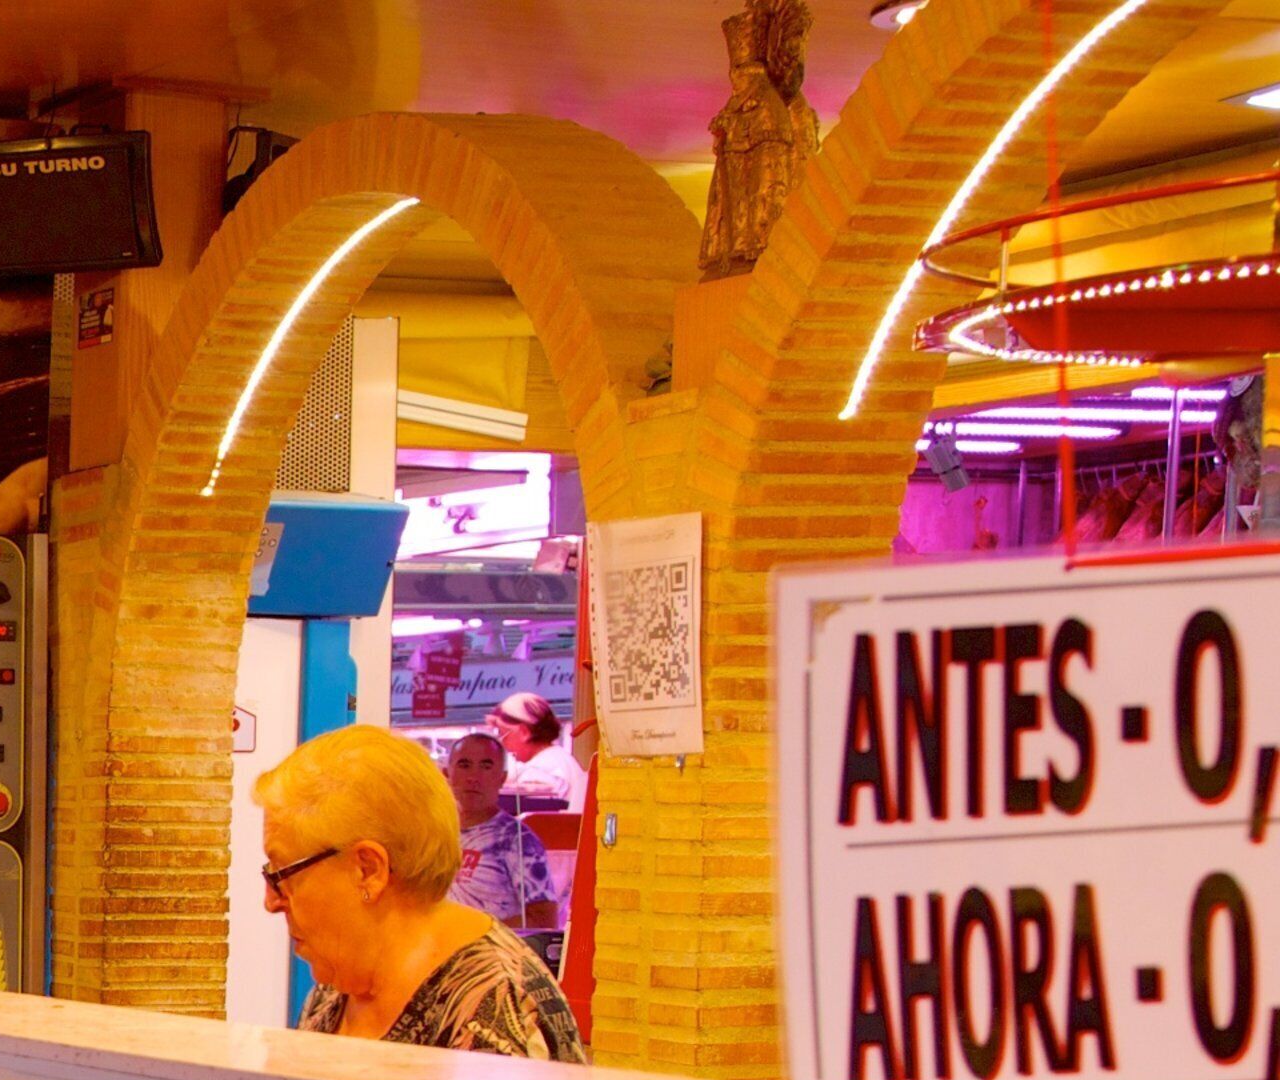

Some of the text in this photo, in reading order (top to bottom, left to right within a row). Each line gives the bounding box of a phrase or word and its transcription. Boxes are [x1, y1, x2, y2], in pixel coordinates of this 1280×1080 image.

[24, 156, 105, 174] TURNO
[450, 671, 517, 699] mparo
[838, 617, 1096, 826] ANTES
